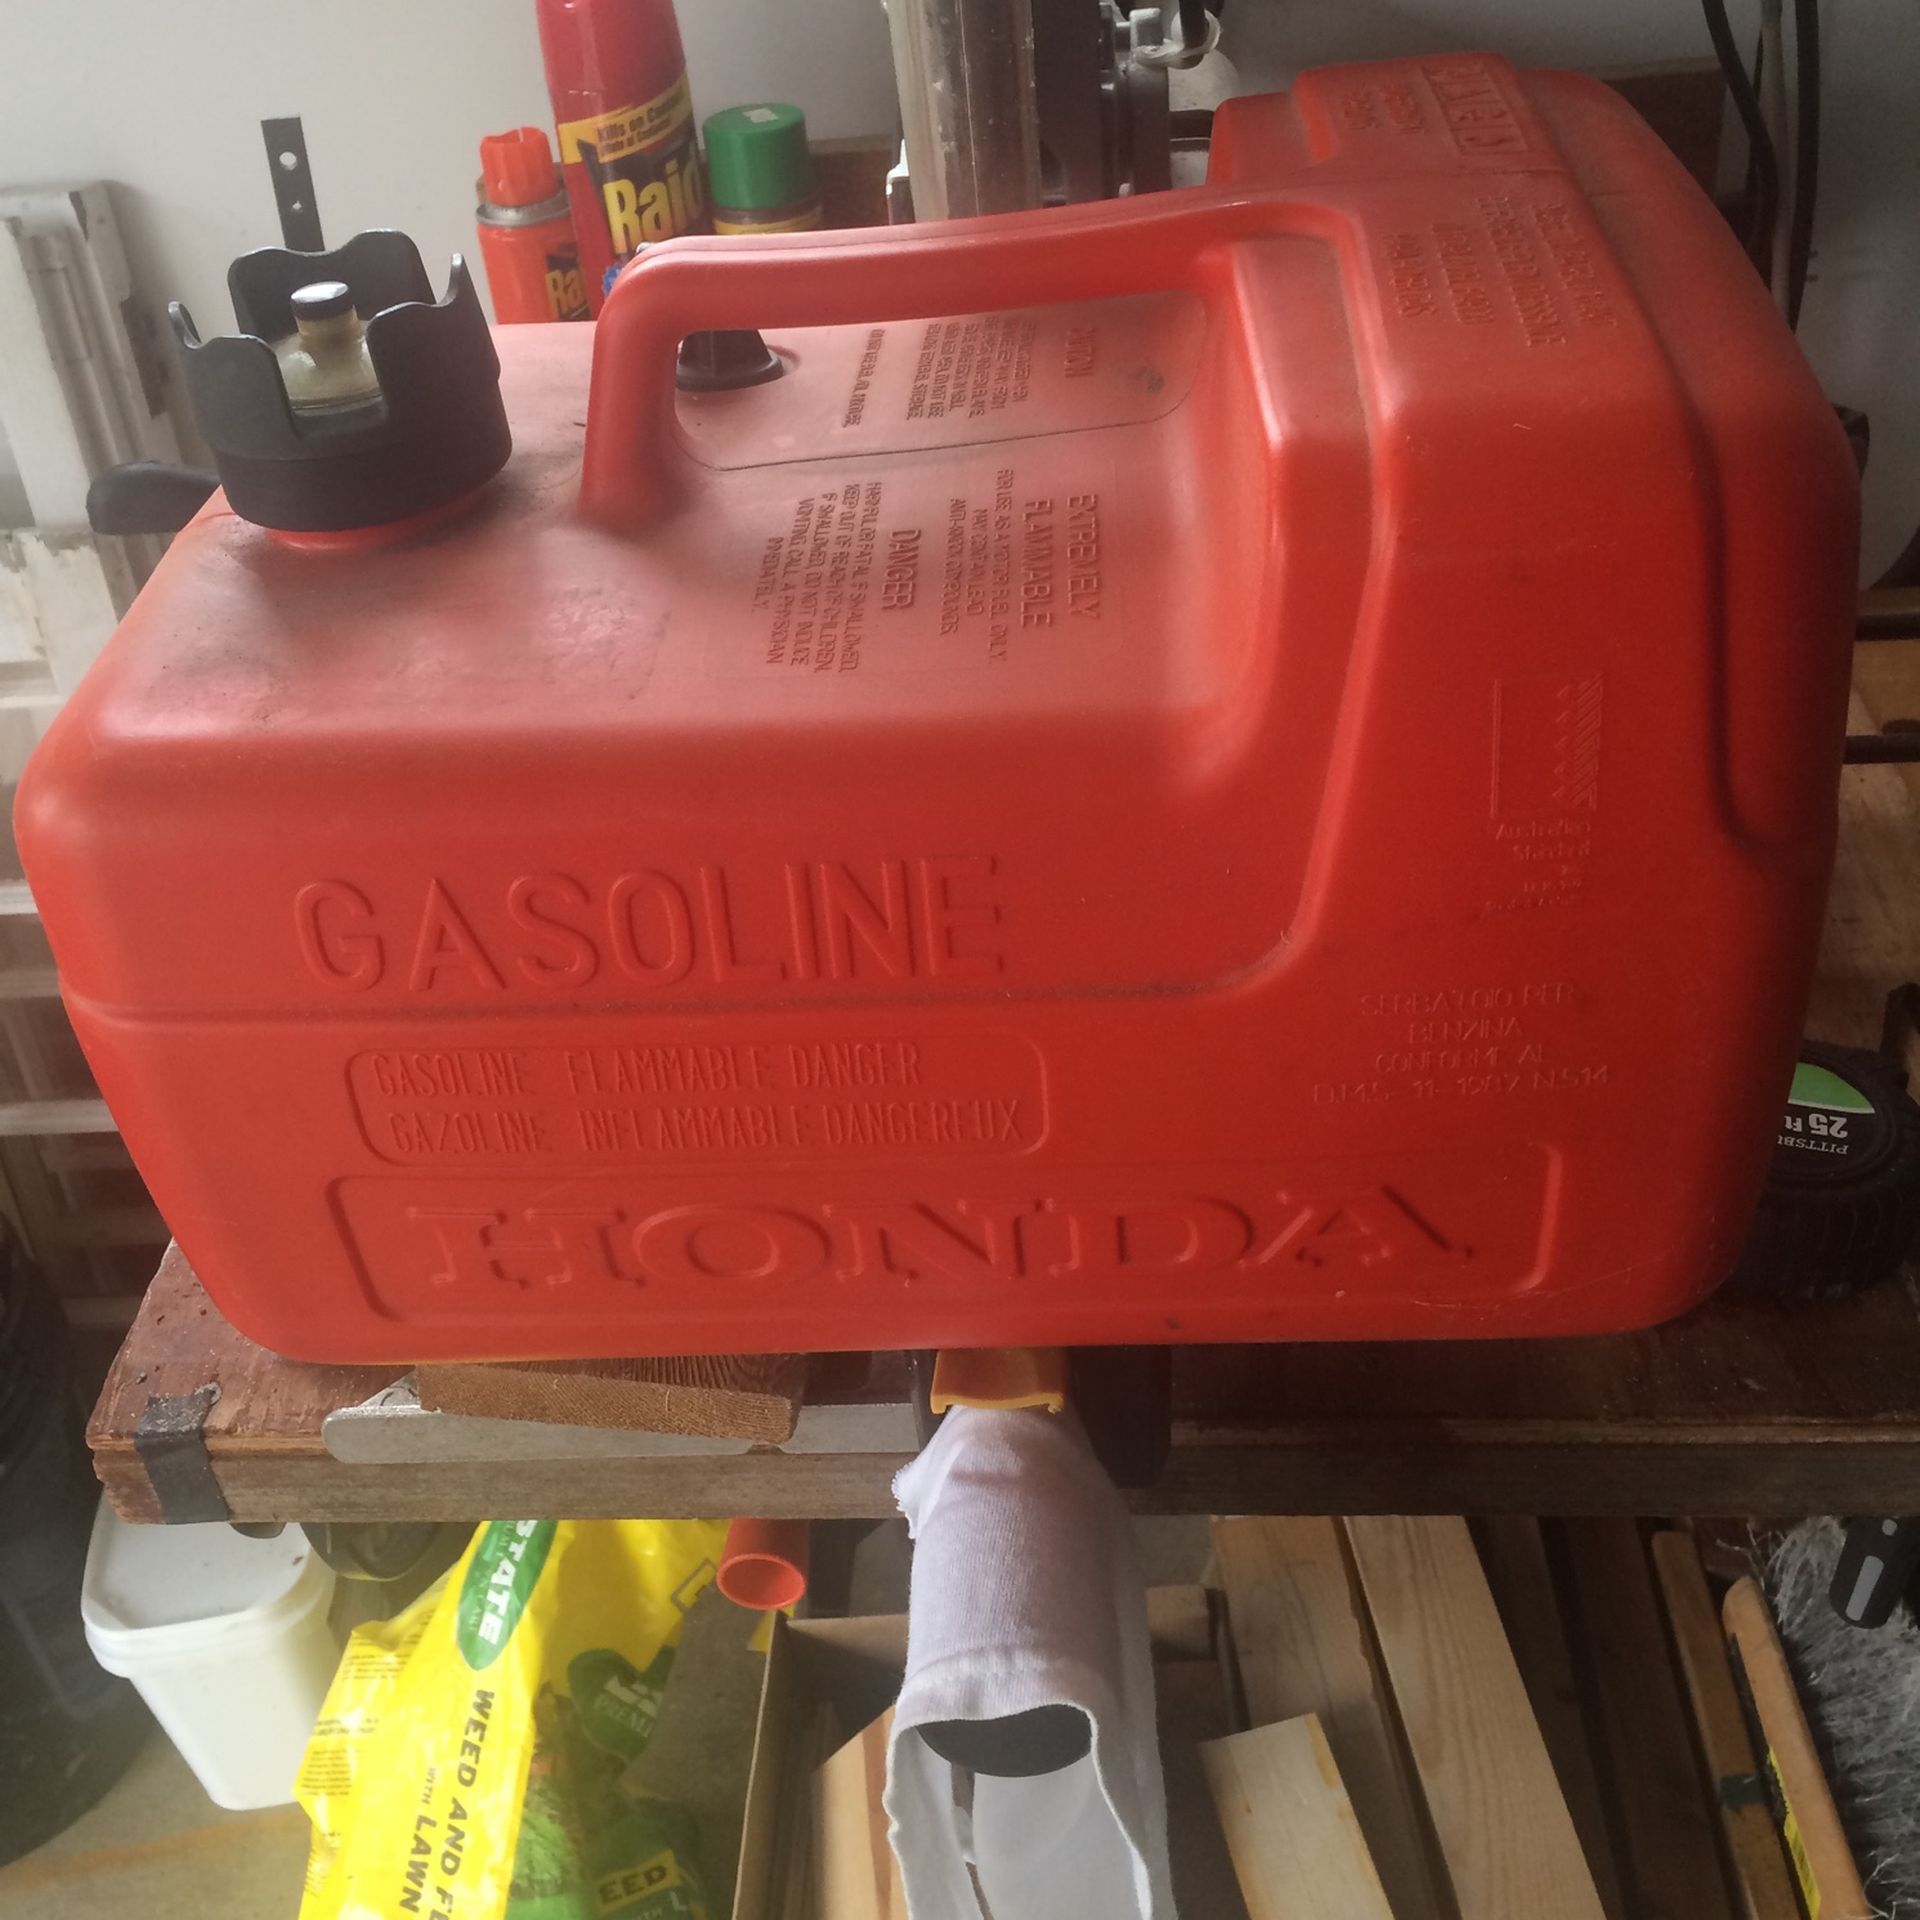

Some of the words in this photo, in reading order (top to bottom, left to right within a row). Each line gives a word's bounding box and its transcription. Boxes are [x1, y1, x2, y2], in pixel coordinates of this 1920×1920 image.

[881, 529, 922, 610] DANGER
[1021, 497, 1054, 628] FLAMMABLE
[1066, 493, 1101, 619] EXTREMELY
[294, 856, 1004, 991] GASOLINE
[371, 1049, 527, 1097] GASOLINE
[564, 1043, 773, 1094] FLAMMABLE
[789, 1040, 922, 1089] DANGER
[387, 1110, 546, 1155] GAZOLINE
[577, 1104, 805, 1152] INFLAMMABLE
[823, 1099, 1024, 1145] DANGEREUX
[1808, 1113, 1849, 1139] 25
[404, 1185, 1477, 1290] HONDA
[457, 1689, 495, 1788] WEED
[400, 1814, 437, 1914] LAWN
[440, 1797, 468, 1877] AND
